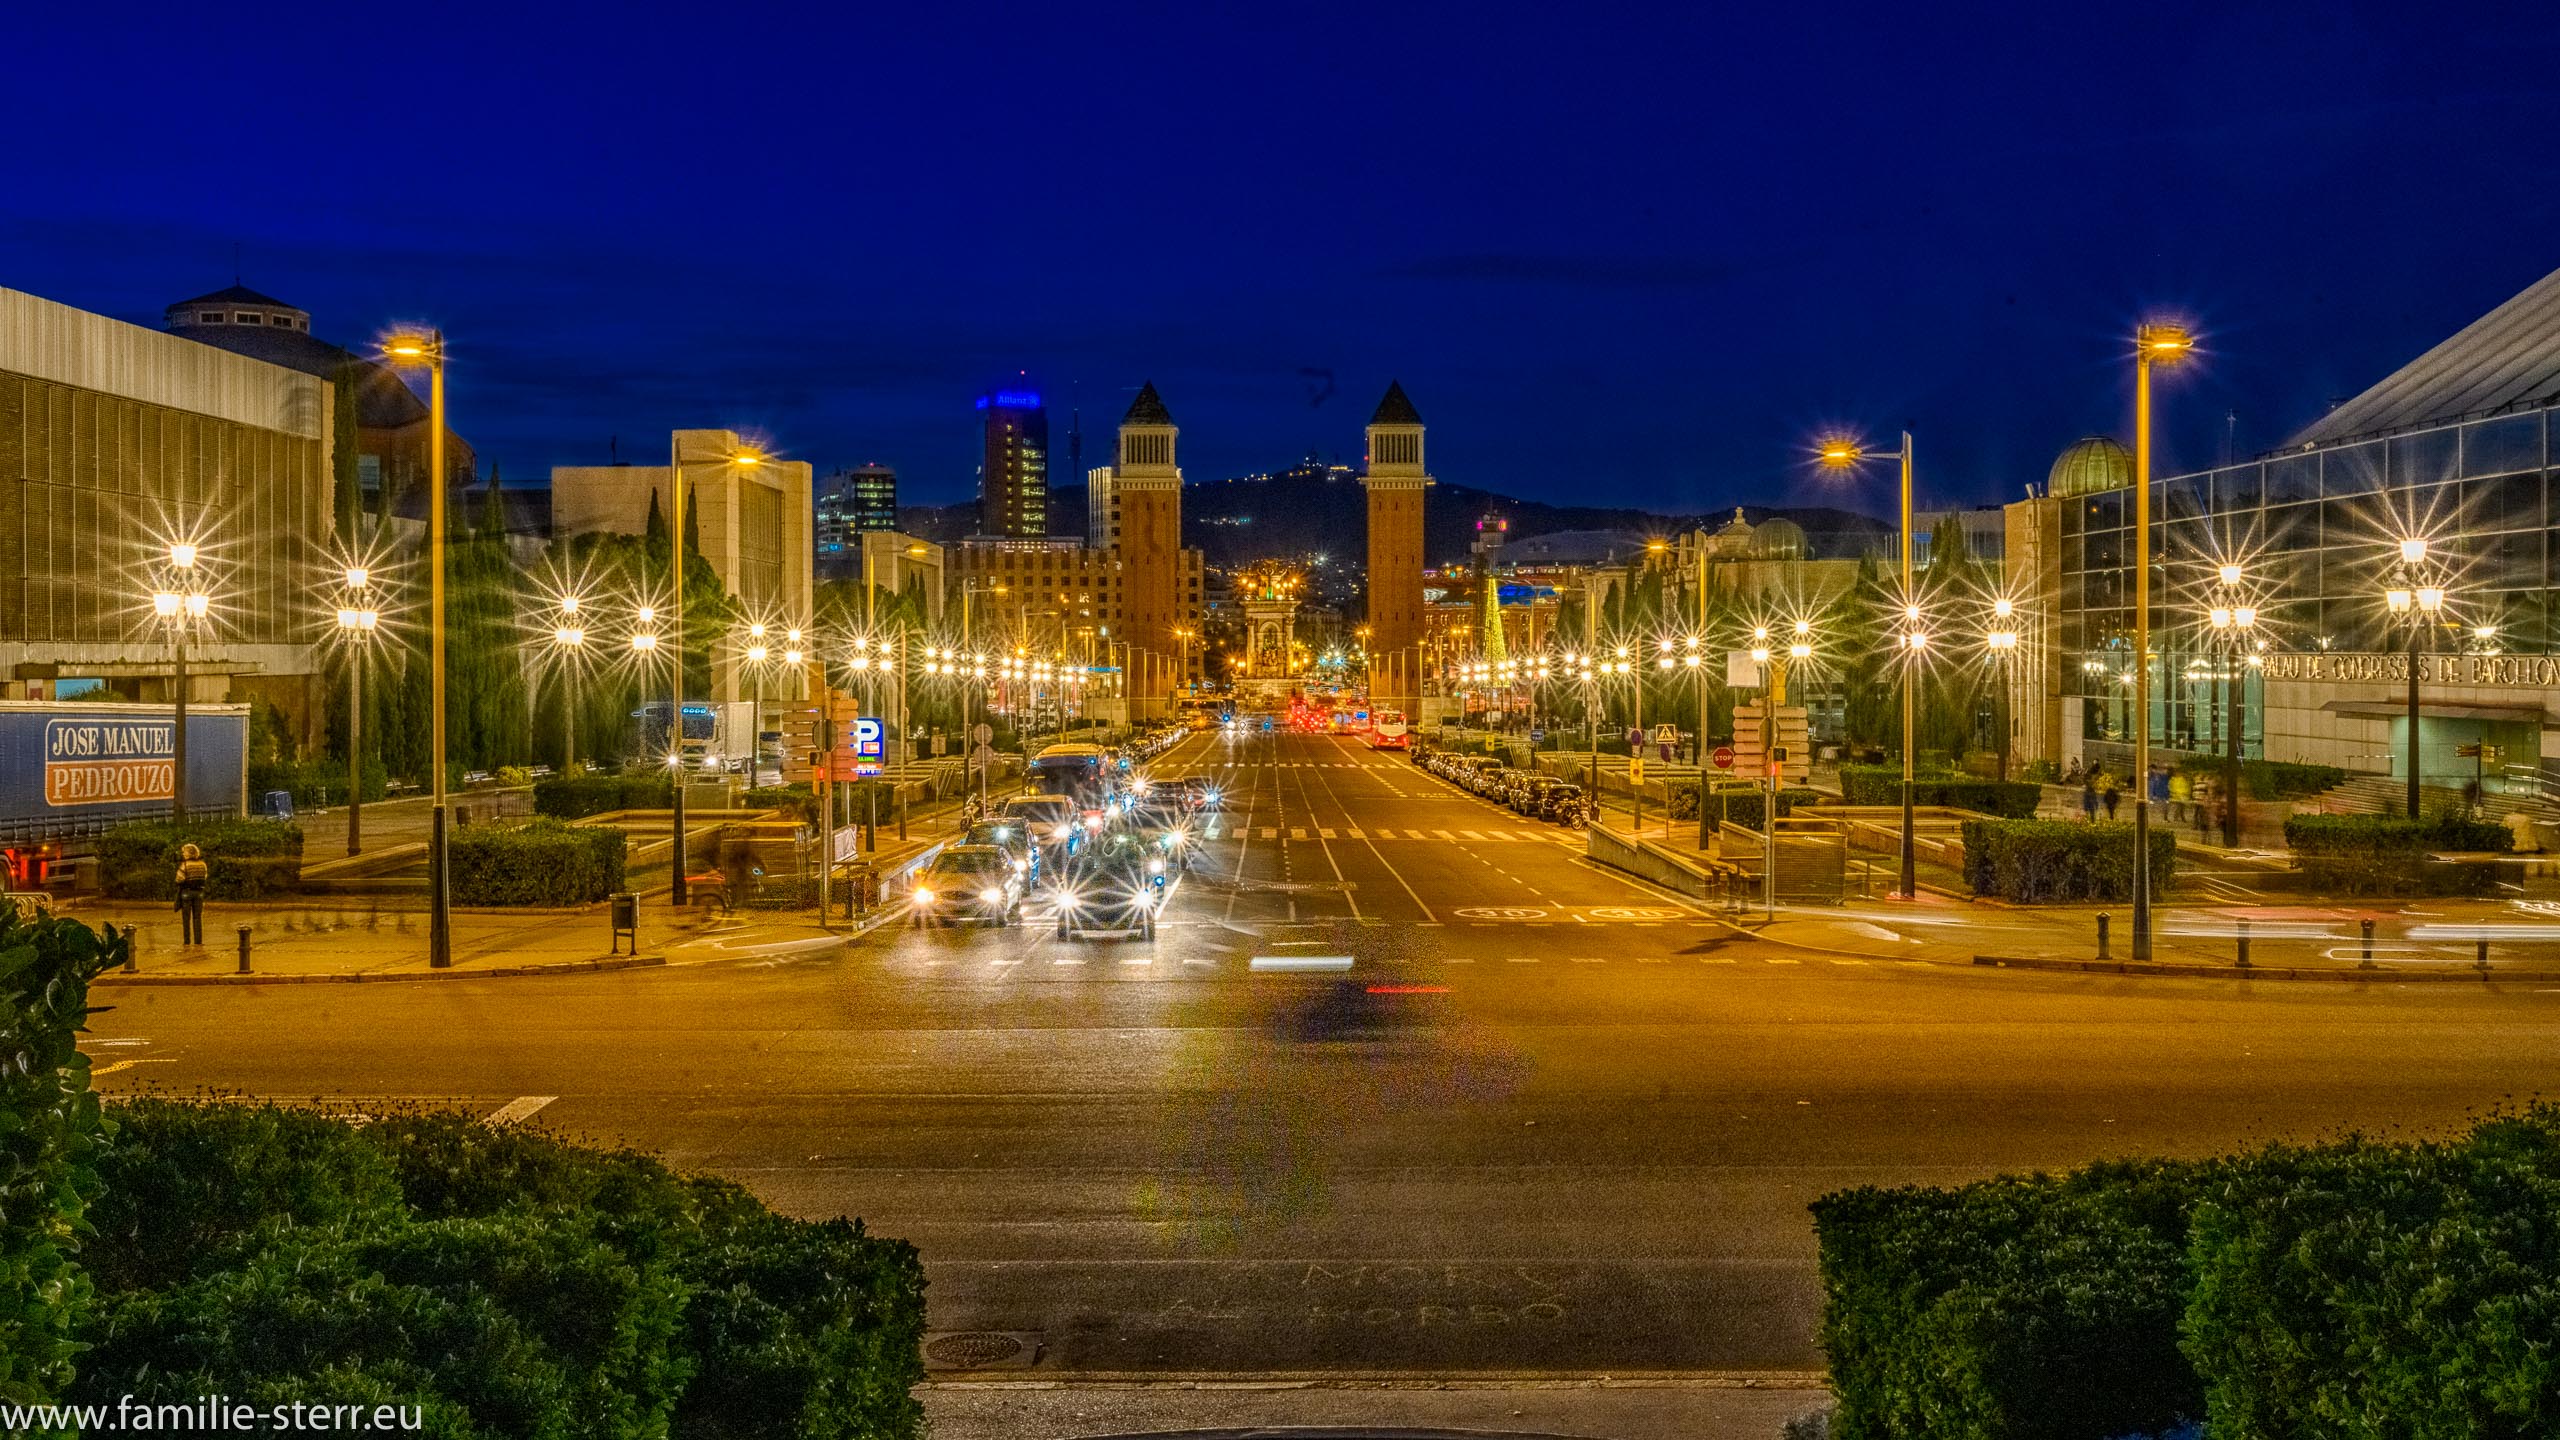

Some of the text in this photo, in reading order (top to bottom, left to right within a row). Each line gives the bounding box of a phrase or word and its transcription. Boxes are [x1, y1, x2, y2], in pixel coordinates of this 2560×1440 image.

[2261, 655, 2299, 678] PALAU
[2306, 656, 2324, 679] DE
[2333, 656, 2429, 681] CONGRESSS
[2439, 657, 2461, 682] DE
[53, 727, 174, 756] JOSE MANUEL
[53, 764, 173, 799] PEDROUZO
